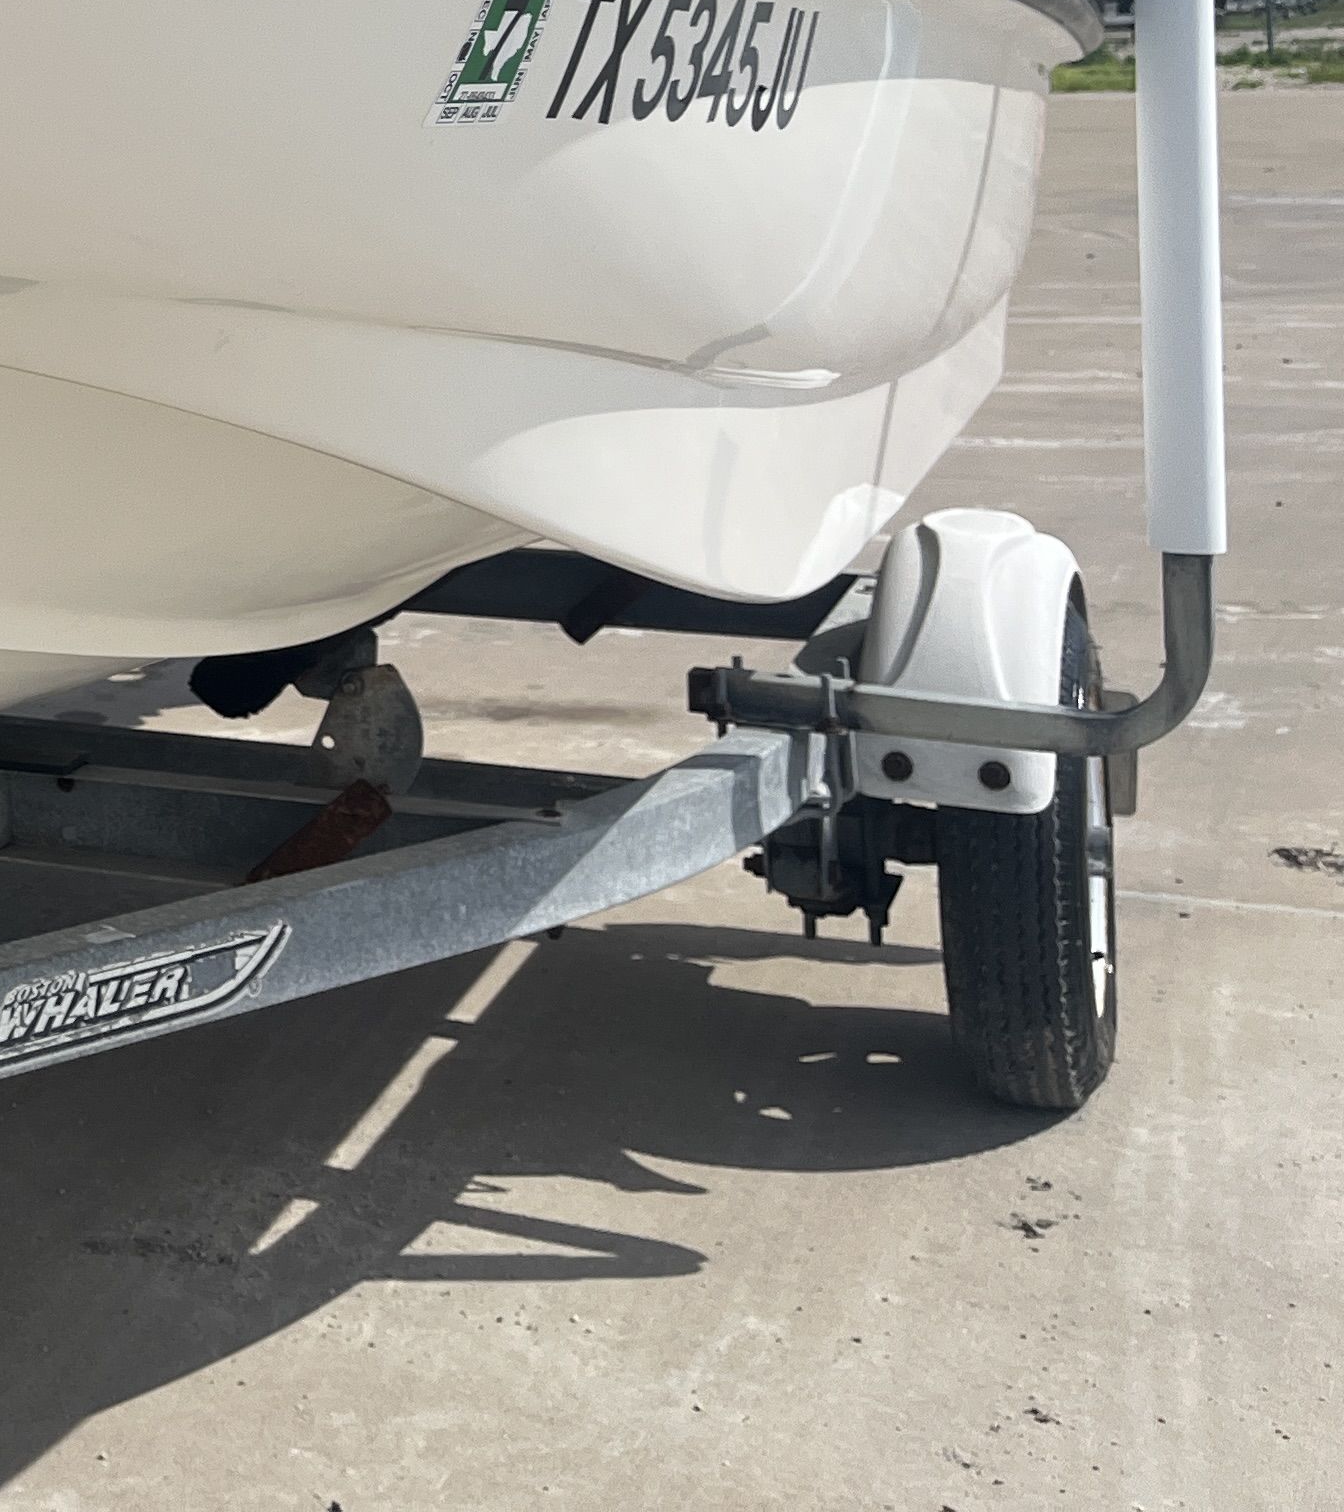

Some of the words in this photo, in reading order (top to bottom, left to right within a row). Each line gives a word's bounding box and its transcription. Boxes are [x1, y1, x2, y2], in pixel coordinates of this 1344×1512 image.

[524, 31, 541, 62] MAY
[440, 72, 458, 101] OCT
[508, 71, 525, 101] JUN
[440, 105, 460, 119] SEP
[461, 105, 481, 119] AUG
[481, 105, 499, 118] JUL
[4, 969, 87, 1006] BOSTON
